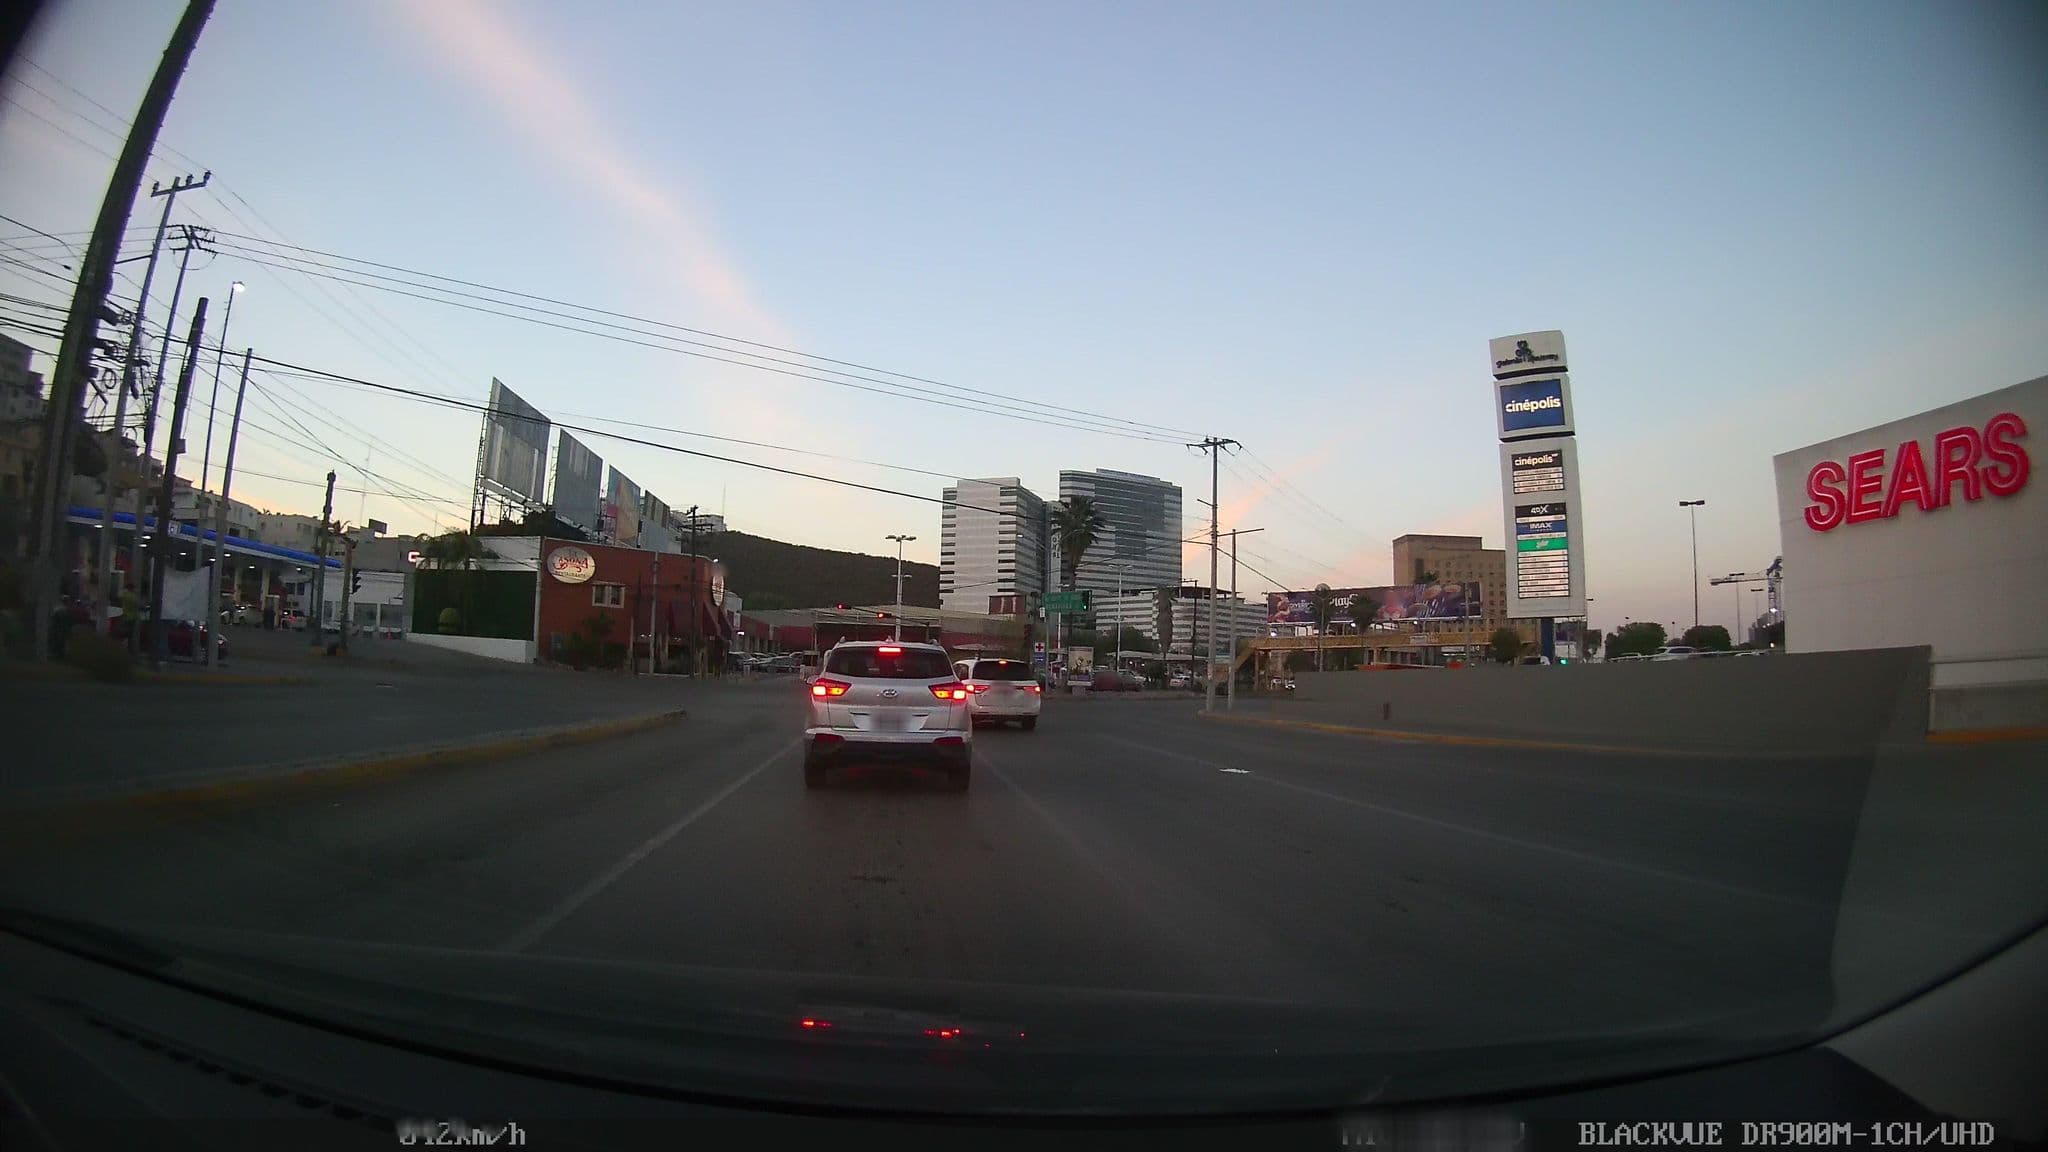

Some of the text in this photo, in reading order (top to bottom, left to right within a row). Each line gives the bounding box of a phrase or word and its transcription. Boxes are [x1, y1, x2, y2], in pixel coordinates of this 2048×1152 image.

[1505, 396, 1561, 412] cinépolis
[1514, 455, 1553, 466] cinépolis
[1804, 412, 2030, 532] SEARS
